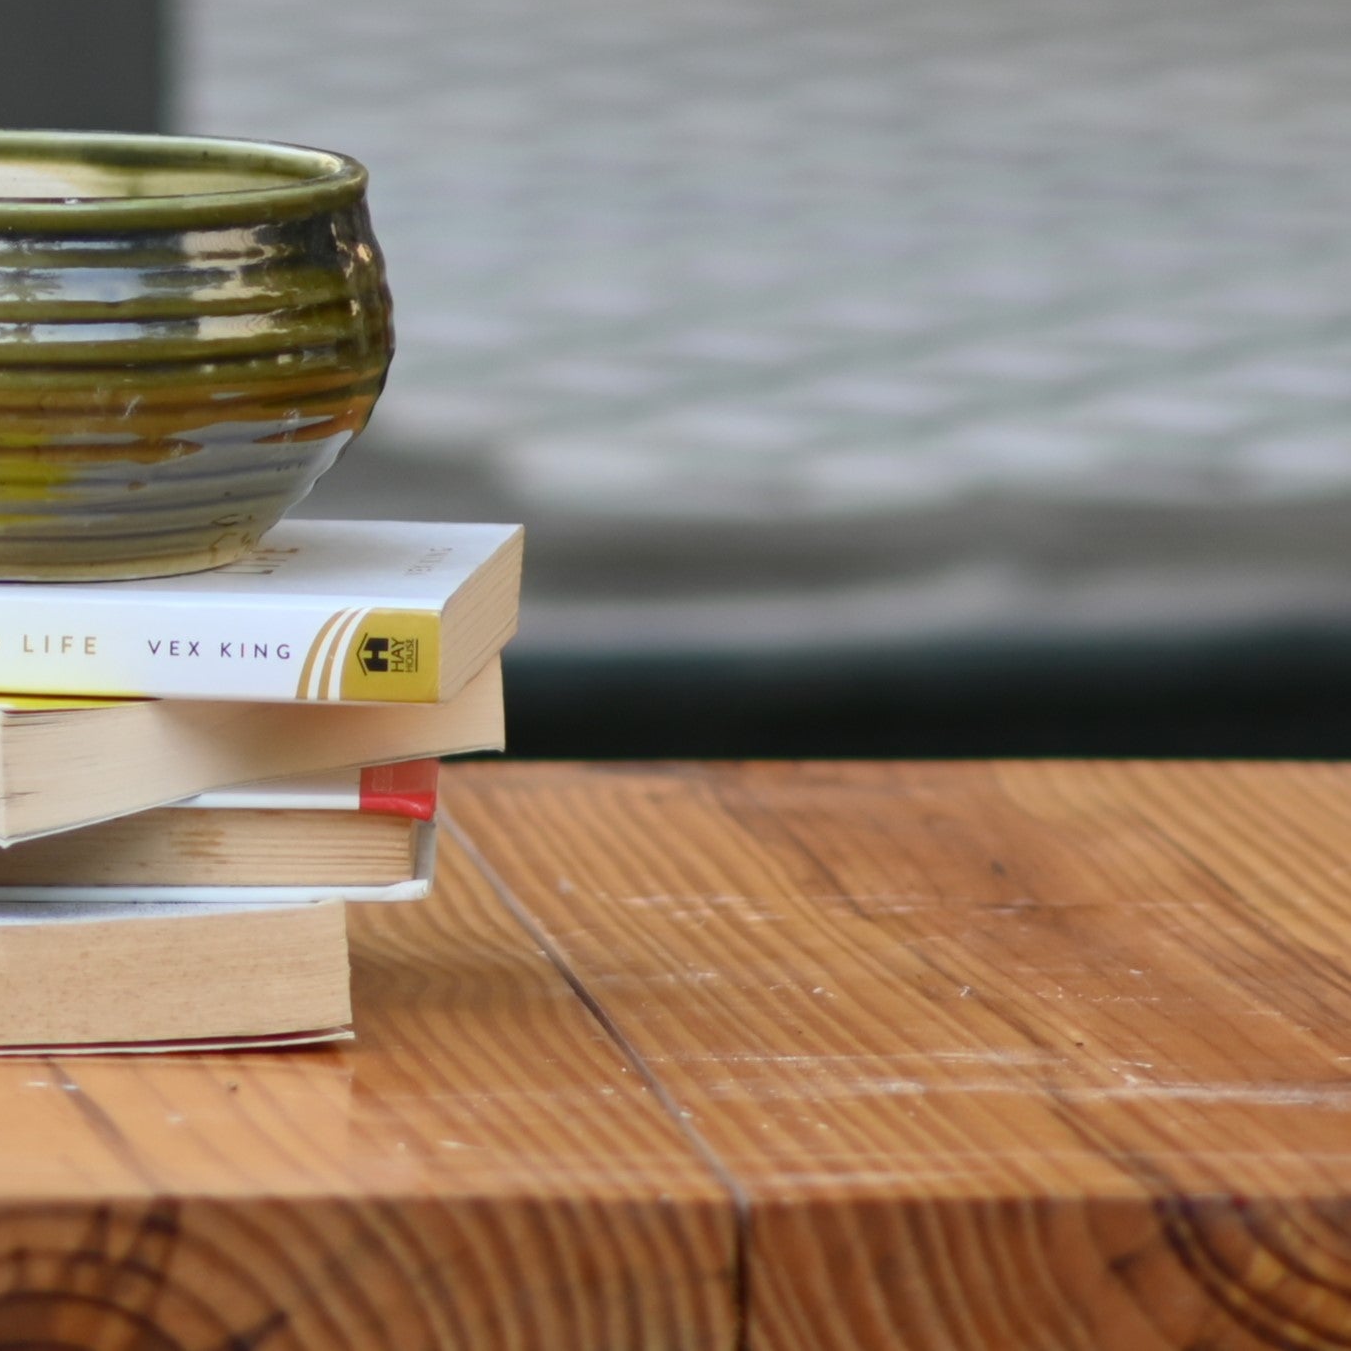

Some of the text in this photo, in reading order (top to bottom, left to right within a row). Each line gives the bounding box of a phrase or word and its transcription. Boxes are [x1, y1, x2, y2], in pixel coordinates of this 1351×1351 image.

[22, 634, 97, 656] LIFE
[147, 639, 291, 661] VEX KING
[391, 637, 404, 672] HAY
[405, 638, 414, 672] HOUSE
